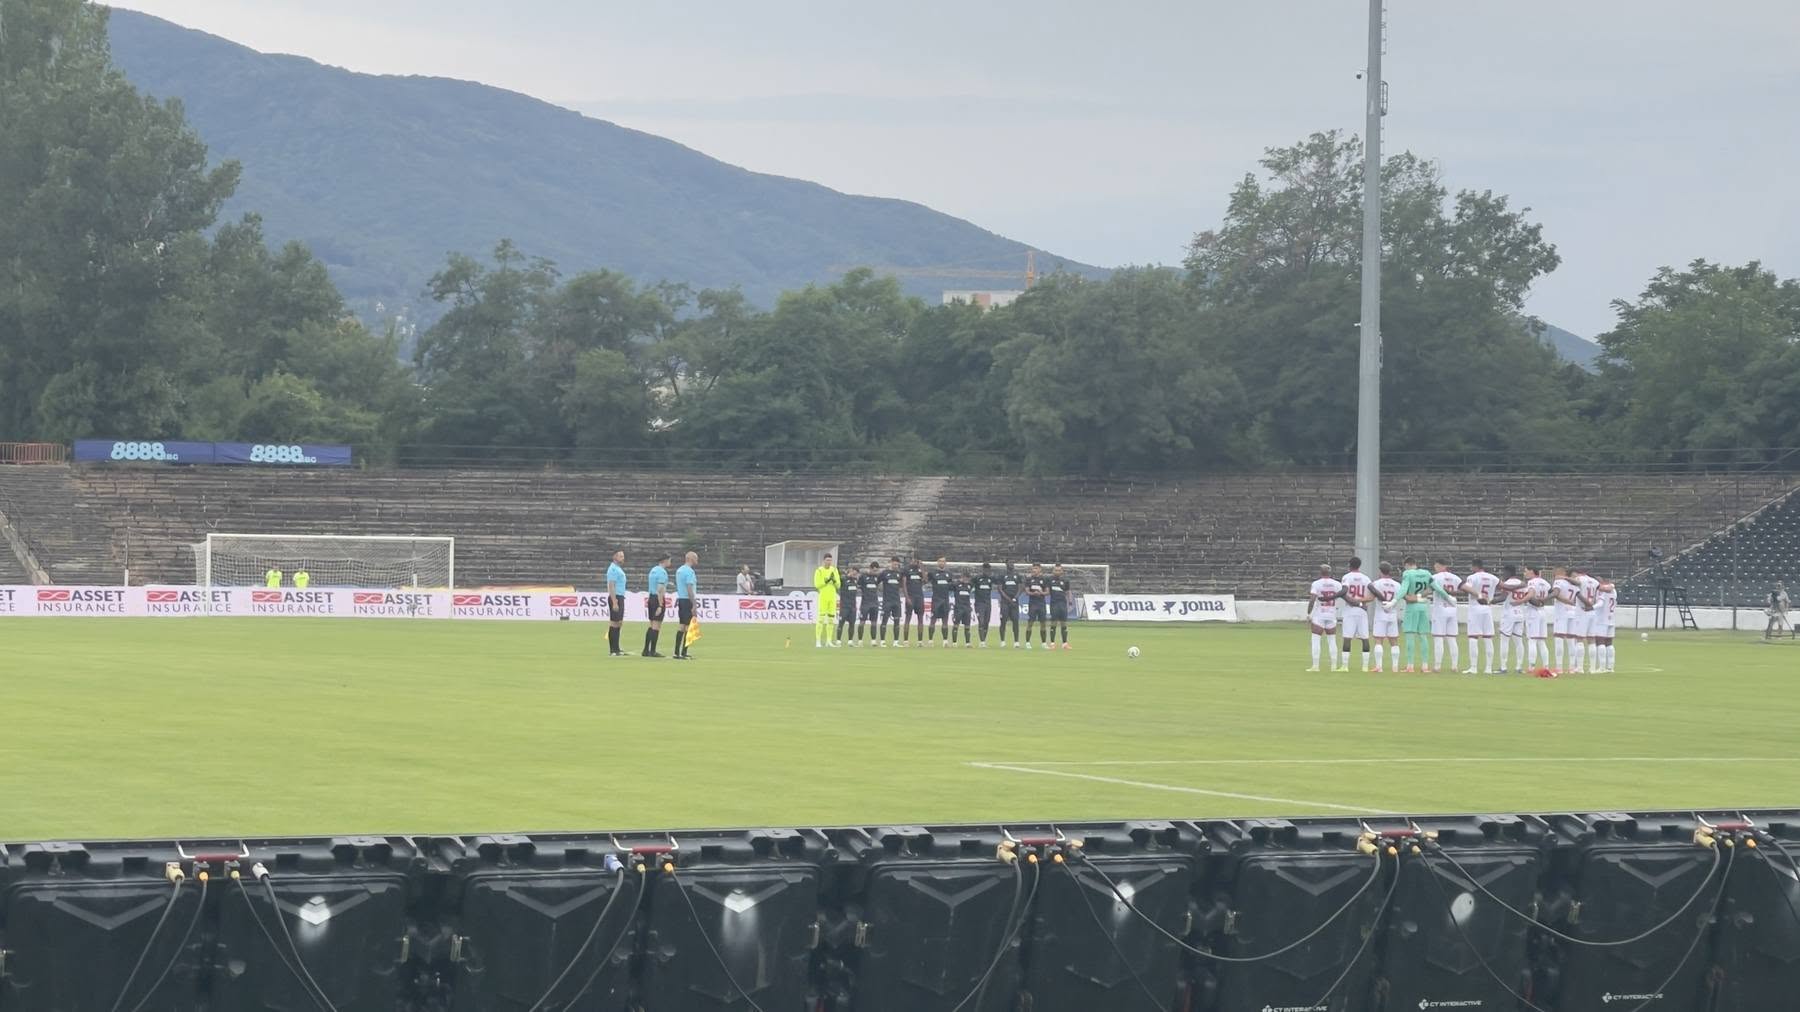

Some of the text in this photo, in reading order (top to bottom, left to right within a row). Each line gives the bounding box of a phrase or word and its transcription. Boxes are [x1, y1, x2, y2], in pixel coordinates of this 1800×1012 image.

[72, 590, 125, 601] ASSET
[284, 591, 334, 603] ASSET
[1481, 585, 1489, 597] 5
[384, 593, 433, 605] ASSET
[483, 594, 531, 606] ASSET
[767, 599, 813, 611] ASSET
[37, 602, 125, 612] INSURANCE
[252, 603, 334, 613] INSURANCE
[453, 607, 532, 617] INSURANCE
[1109, 600, 1156, 615] Joma
[1178, 600, 1226, 616] Joma
[739, 610, 813, 621] INSURANCE
